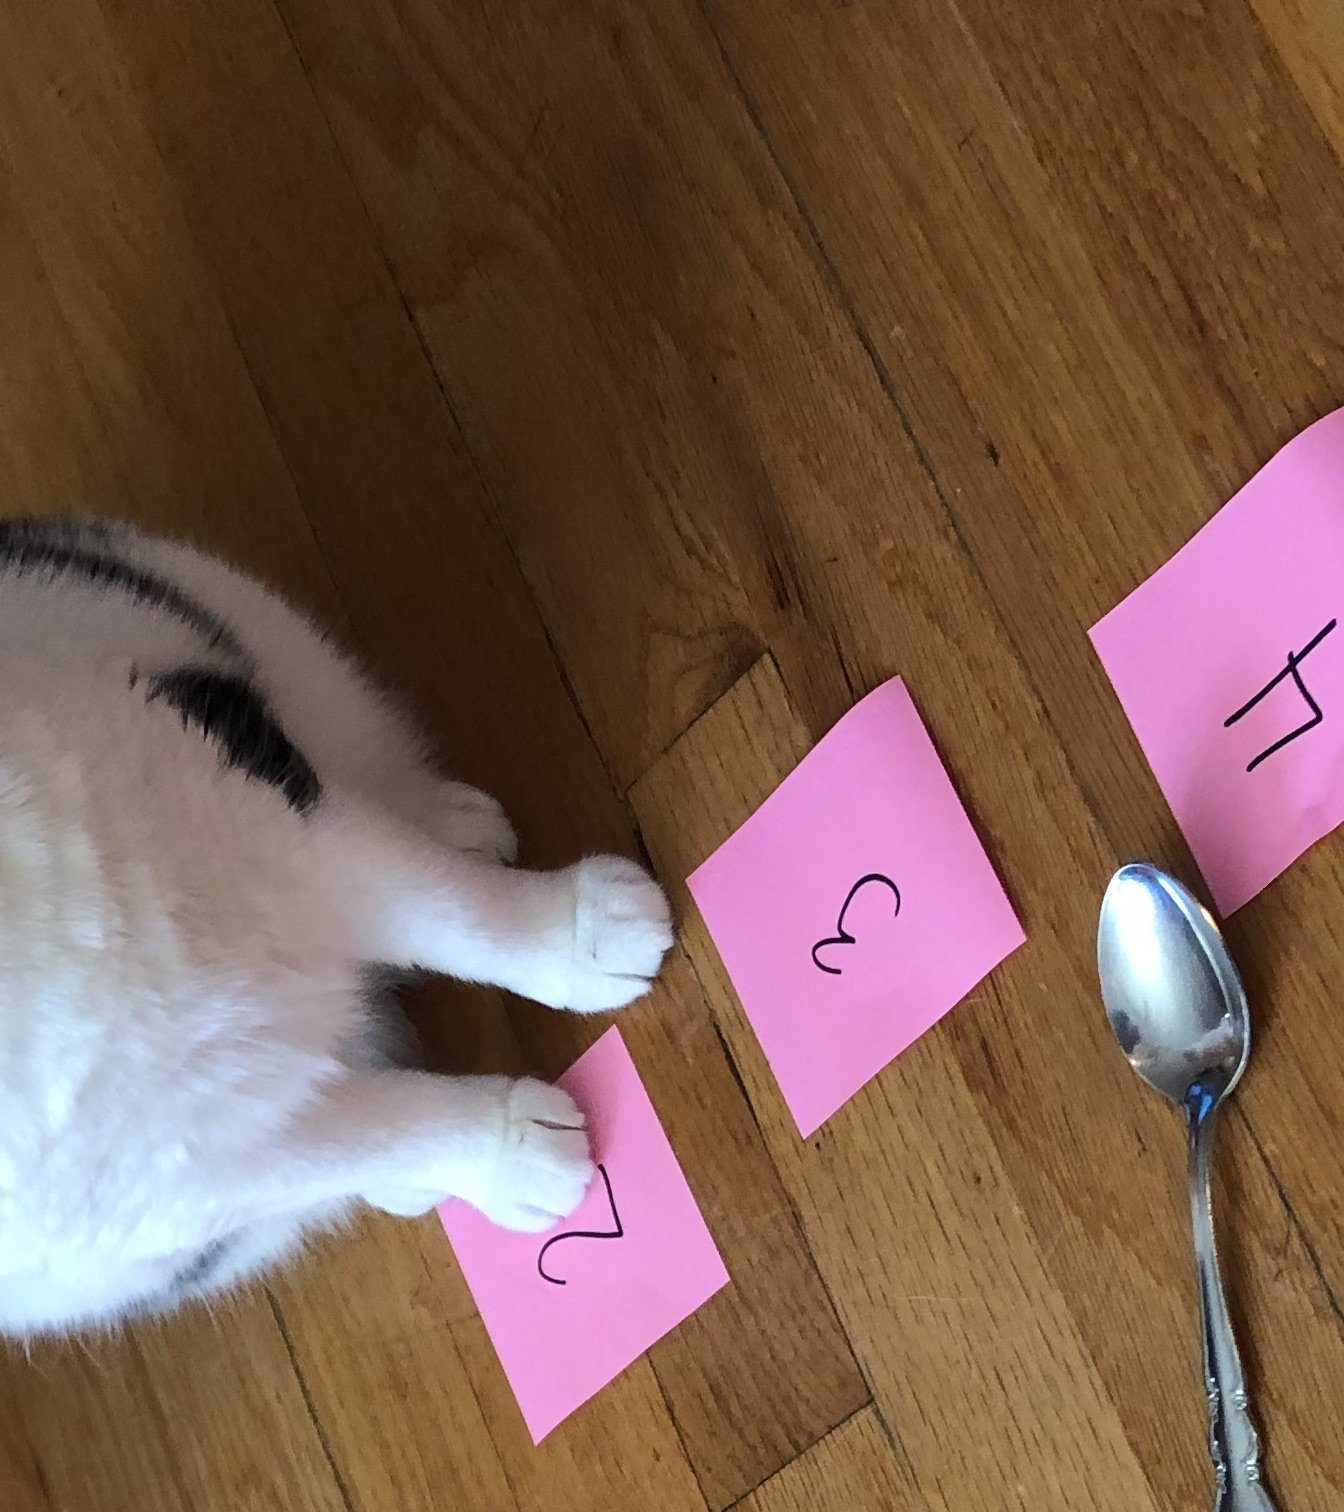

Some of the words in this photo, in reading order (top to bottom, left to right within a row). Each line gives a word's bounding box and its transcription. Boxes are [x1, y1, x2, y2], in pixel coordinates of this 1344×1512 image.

[1224, 619, 1337, 772] 4
[812, 873, 900, 975] 3
[537, 1163, 623, 1286] 2
